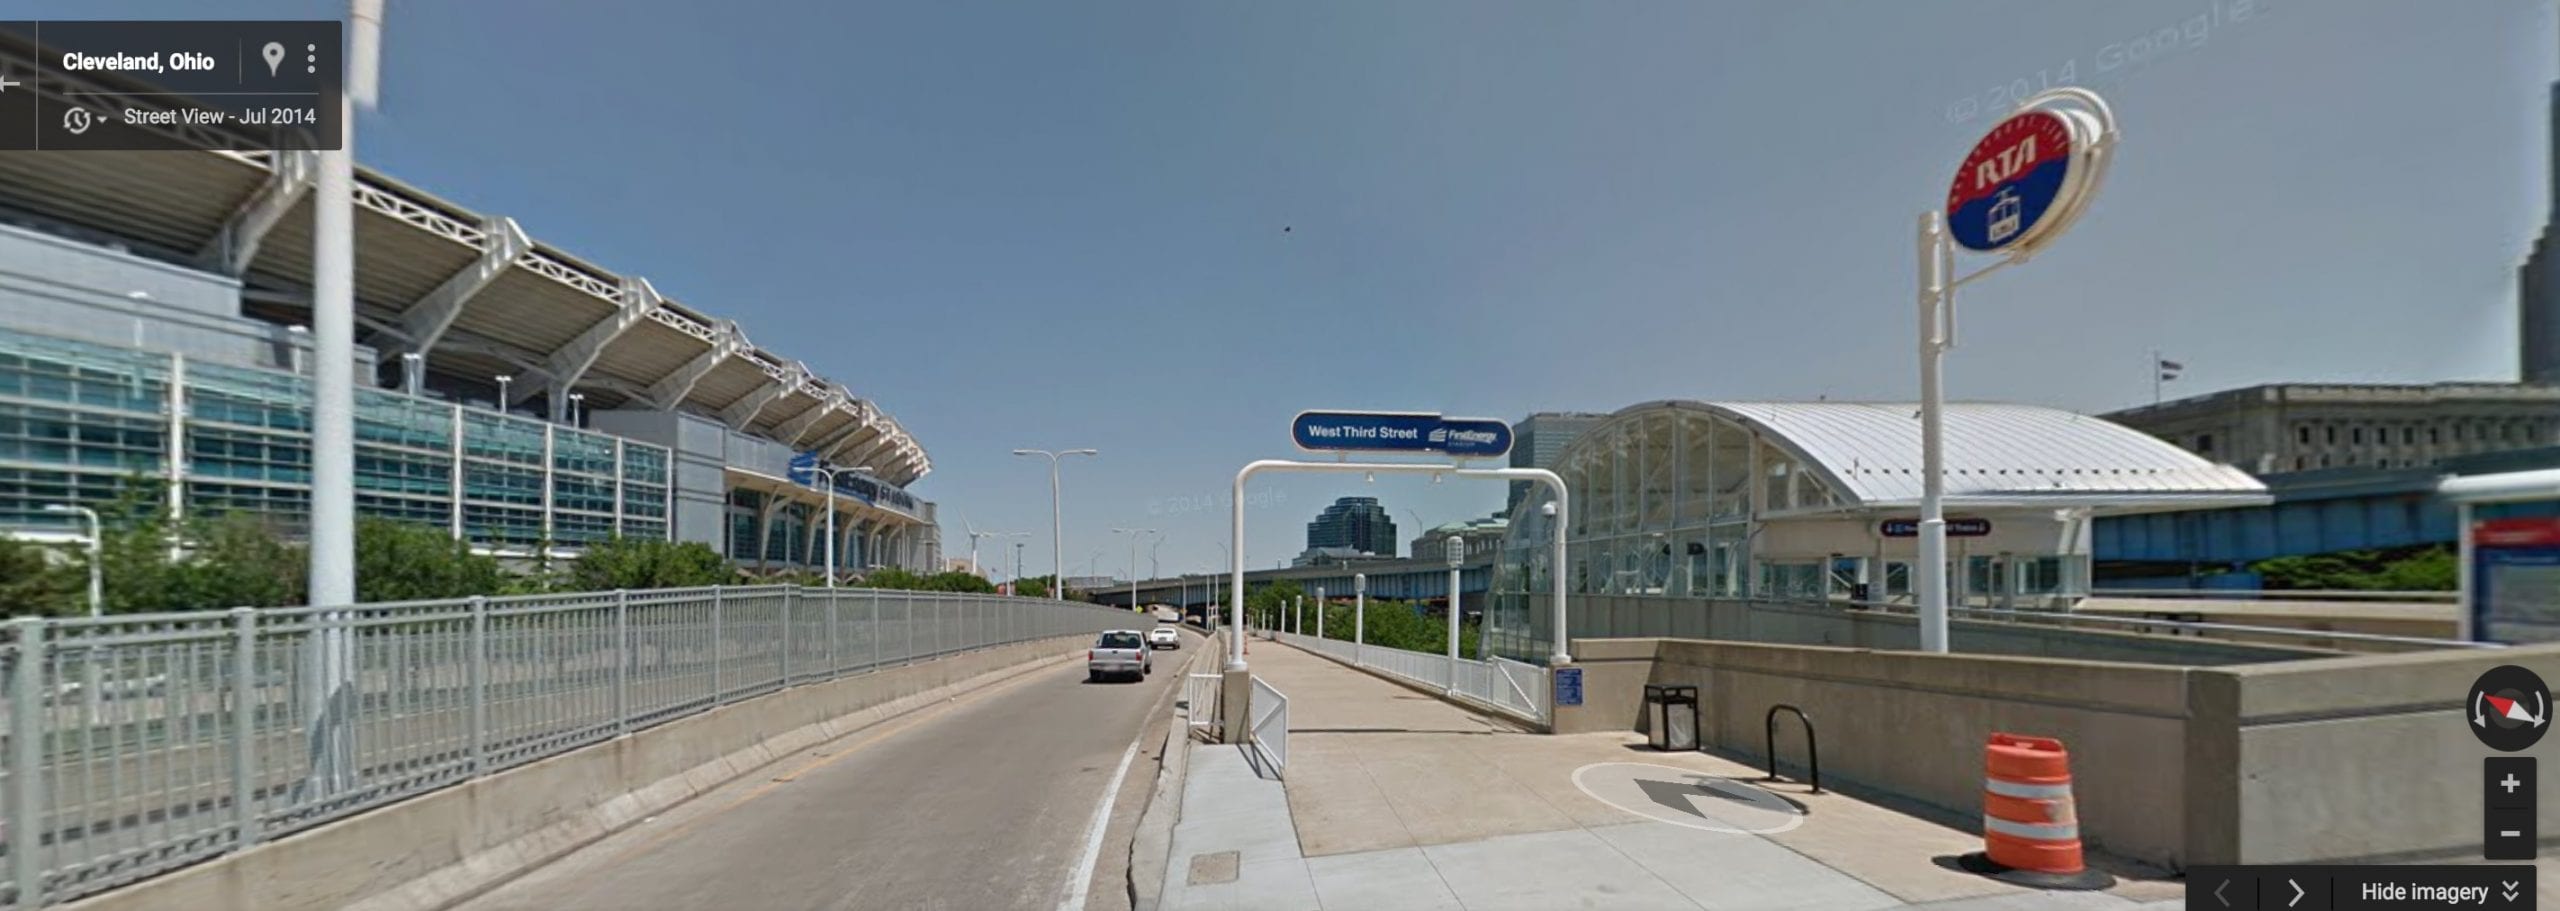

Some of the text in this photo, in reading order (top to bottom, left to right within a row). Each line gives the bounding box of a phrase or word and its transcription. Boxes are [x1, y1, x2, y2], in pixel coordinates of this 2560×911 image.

[1976, 134, 2037, 190] RTA
[1308, 425, 1418, 439] West Third Street
